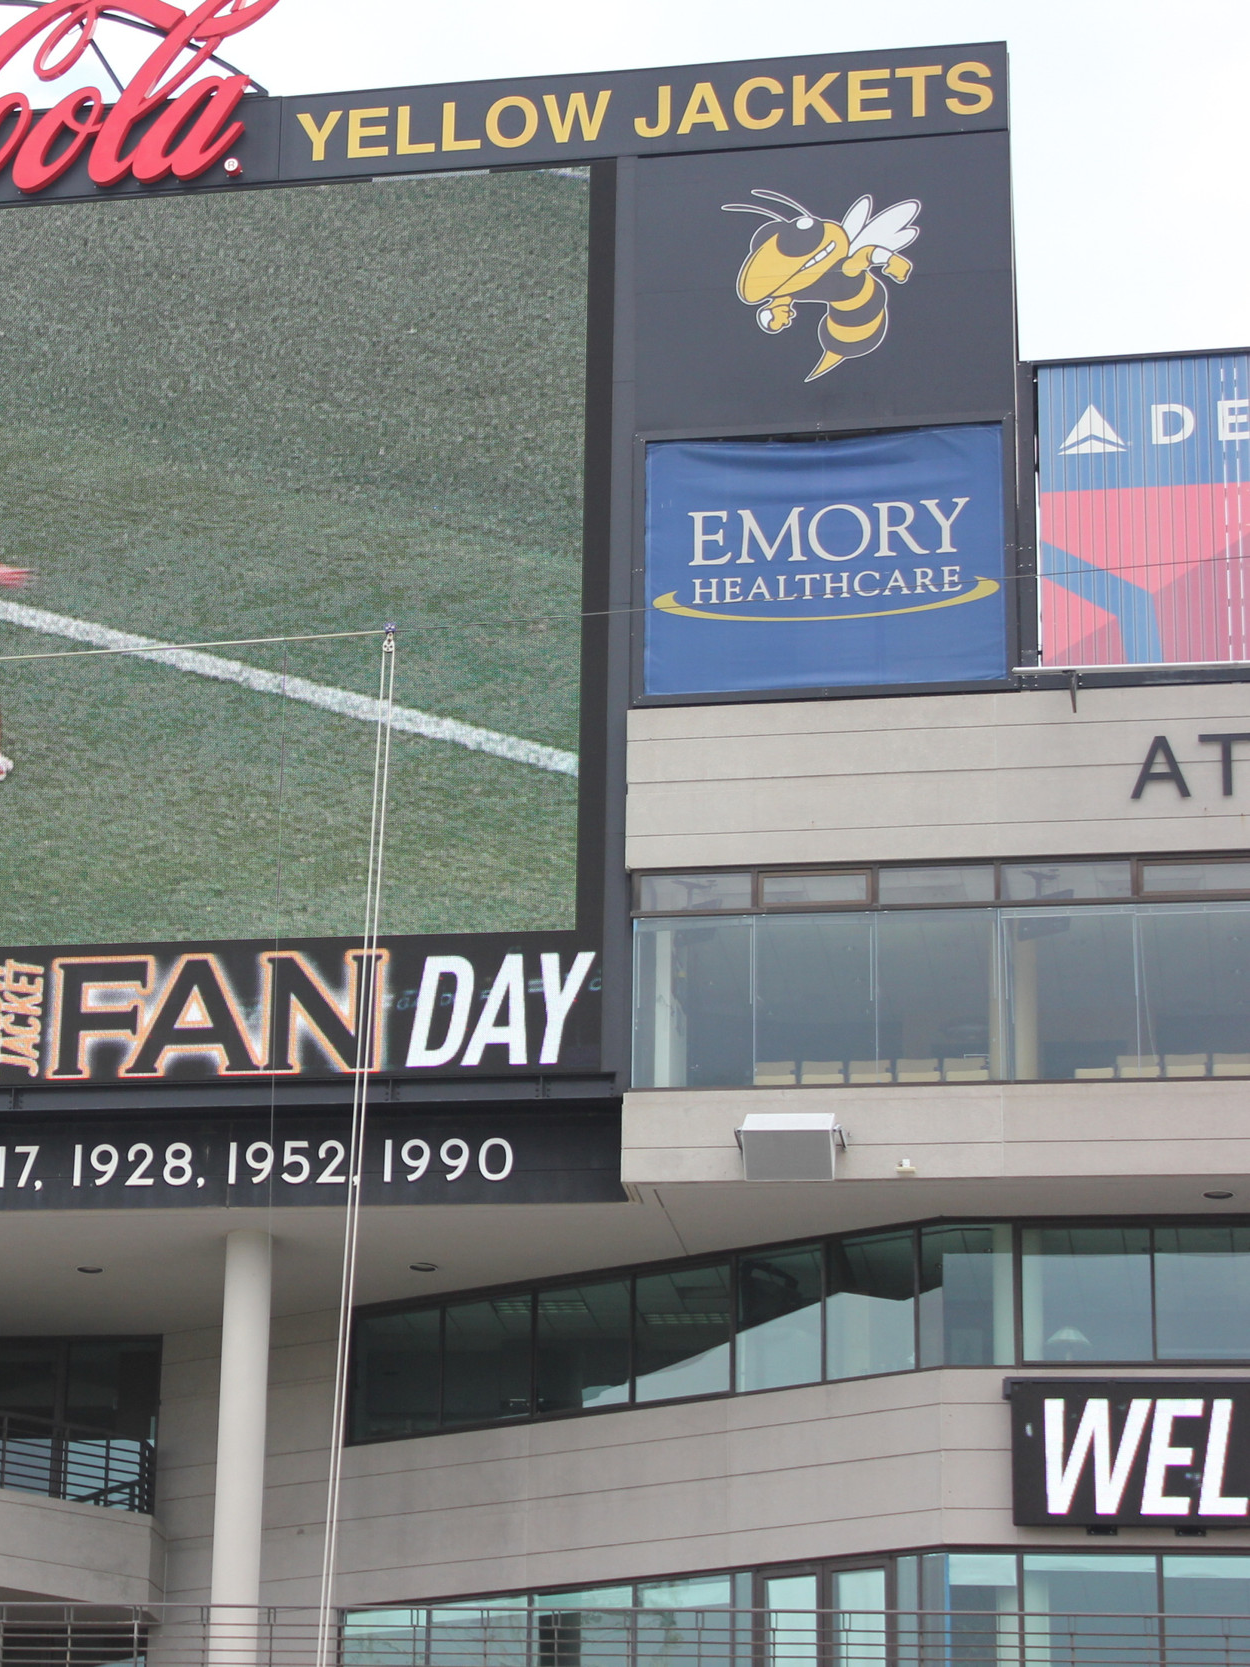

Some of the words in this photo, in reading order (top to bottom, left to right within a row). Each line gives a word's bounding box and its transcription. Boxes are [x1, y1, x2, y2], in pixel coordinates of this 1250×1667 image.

[296, 90, 612, 162] YELLOW
[633, 62, 993, 138] JACKETS
[1151, 399, 1250, 445] DE
[688, 497, 970, 566] EMORY
[691, 566, 963, 604] HEALTHCARE
[1131, 732, 1250, 799] AT
[0, 958, 45, 1077] JACKET
[46, 949, 390, 1080] FAN
[405, 951, 597, 1069] DAY
[72, 1142, 205, 1188] 1928,
[228, 1139, 360, 1186] 1952,
[383, 1137, 514, 1183] 1990
[1044, 1398, 1250, 1515] WEL
